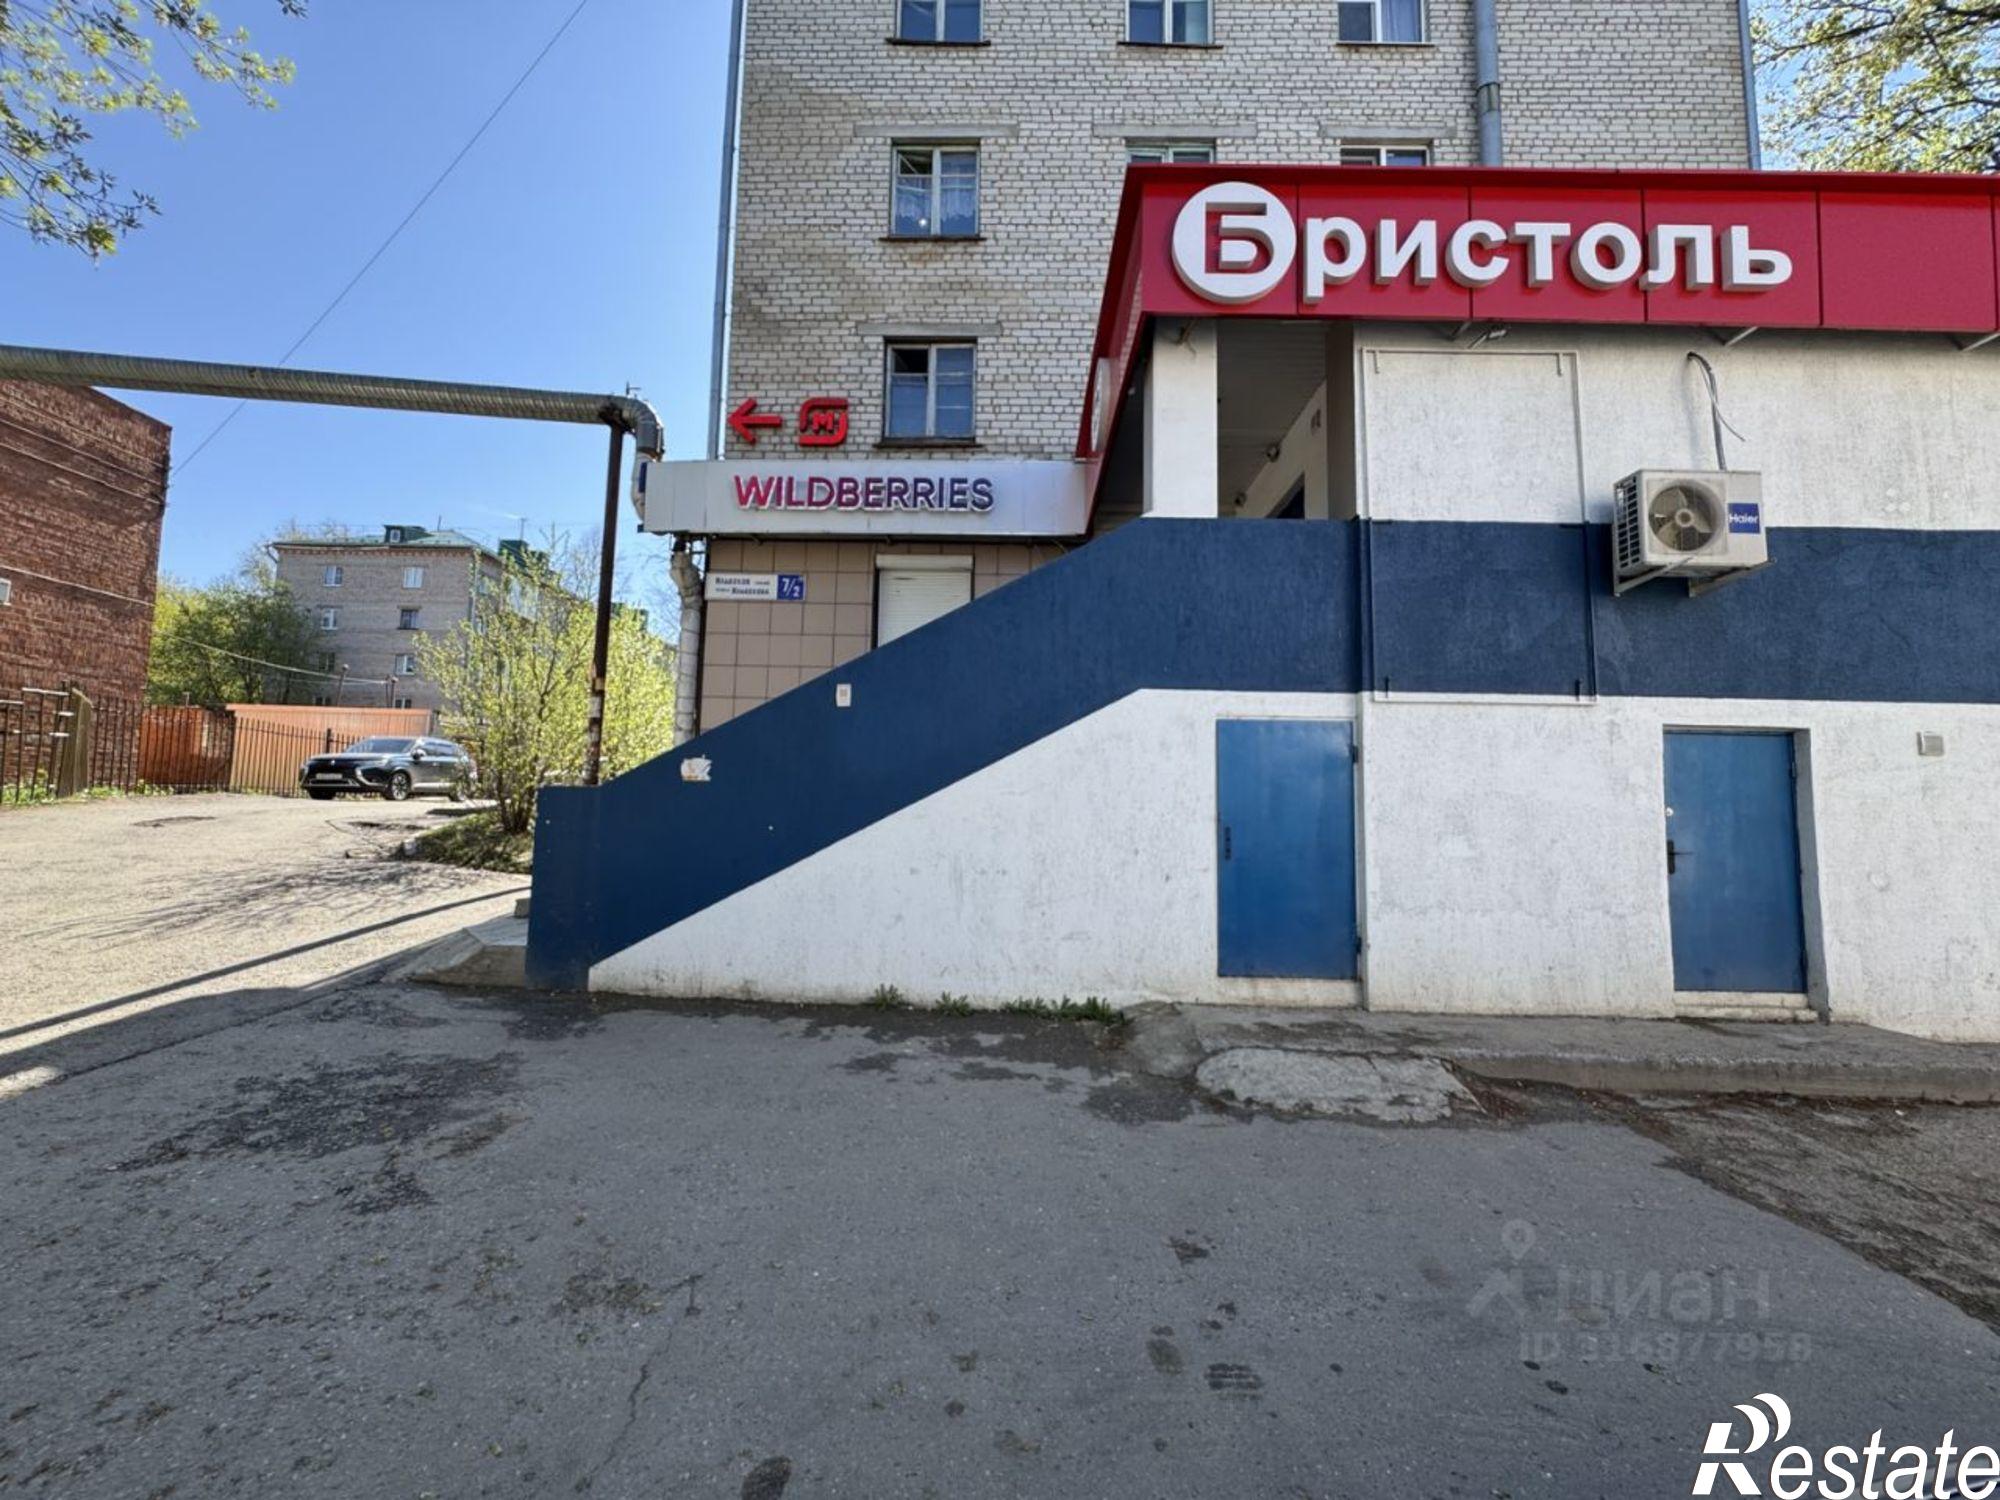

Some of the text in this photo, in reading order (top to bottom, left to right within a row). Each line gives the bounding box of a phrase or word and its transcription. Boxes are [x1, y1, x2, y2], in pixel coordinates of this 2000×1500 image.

[1172, 181, 1793, 304] Бристоль
[734, 475, 995, 514] WILDBERRIES
[1728, 511, 1759, 524] Haier
[781, 577, 801, 598] 7/2
